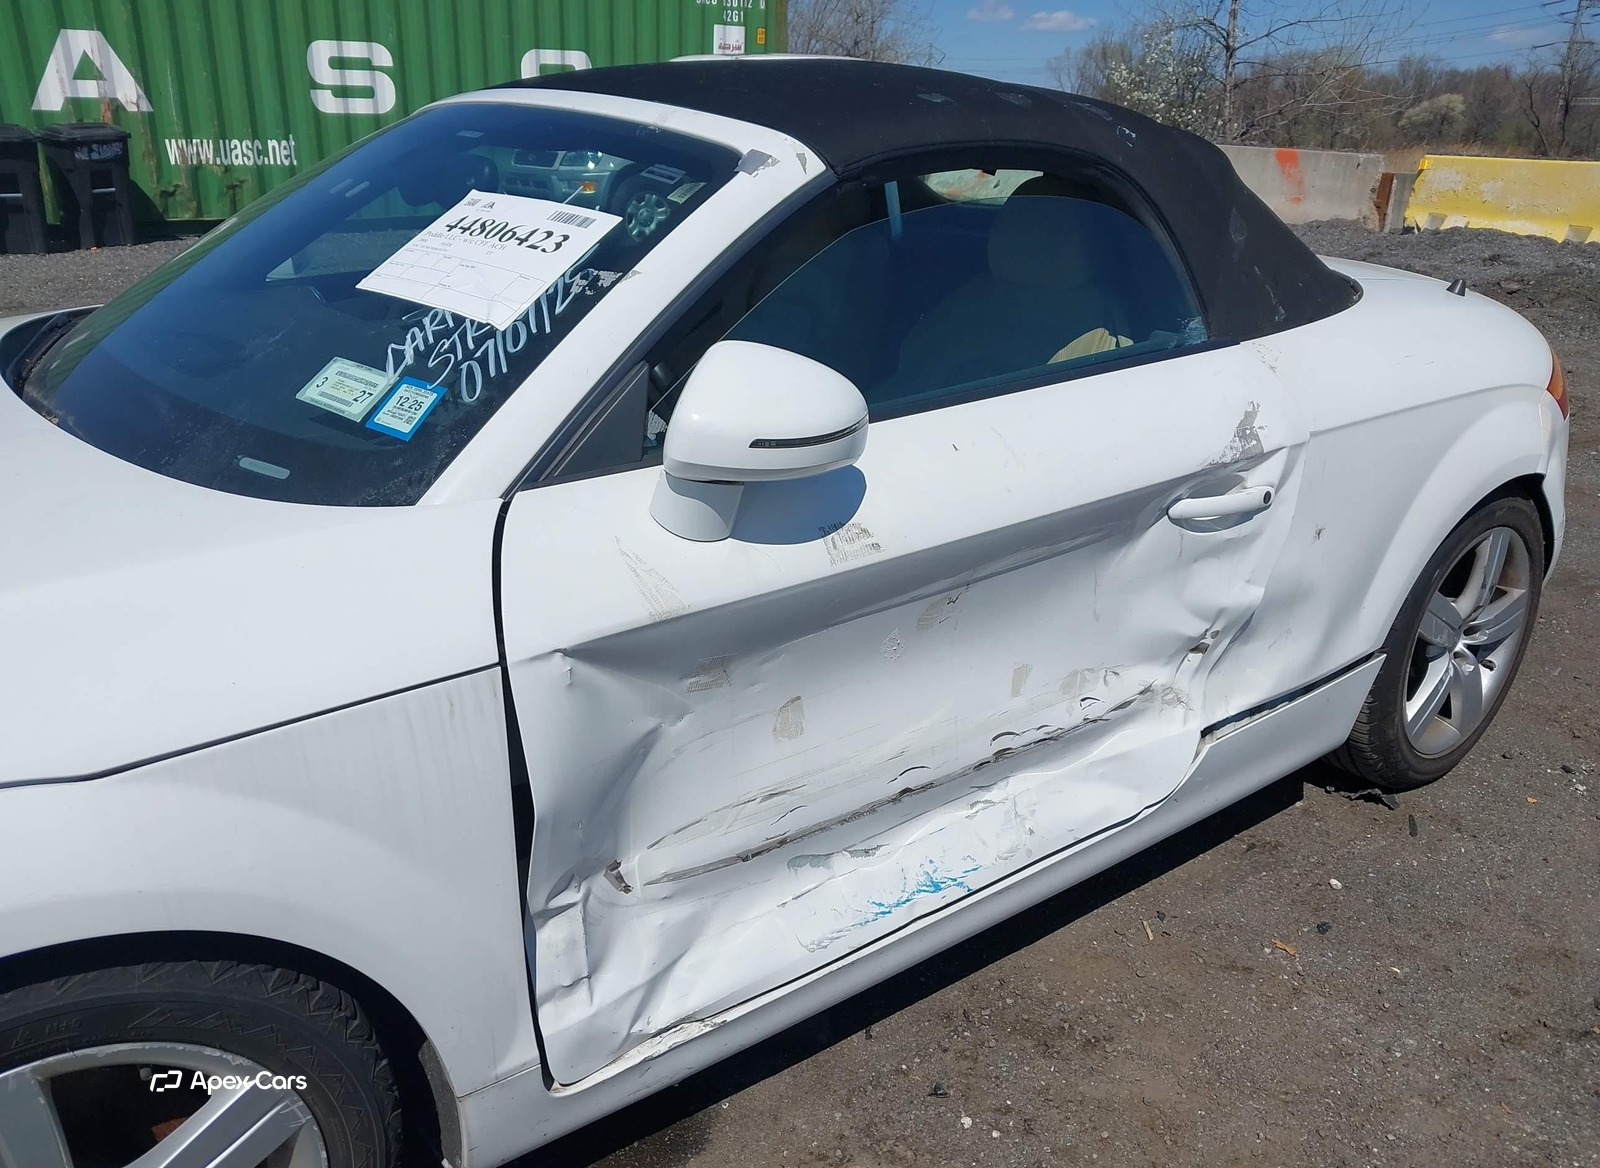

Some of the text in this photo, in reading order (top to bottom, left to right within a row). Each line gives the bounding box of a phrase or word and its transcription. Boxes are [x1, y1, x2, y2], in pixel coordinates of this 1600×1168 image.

[164, 133, 298, 166] www.uasc.net
[444, 215, 570, 254] 44806423
[316, 376, 329, 388] 3
[352, 389, 374, 404] 27
